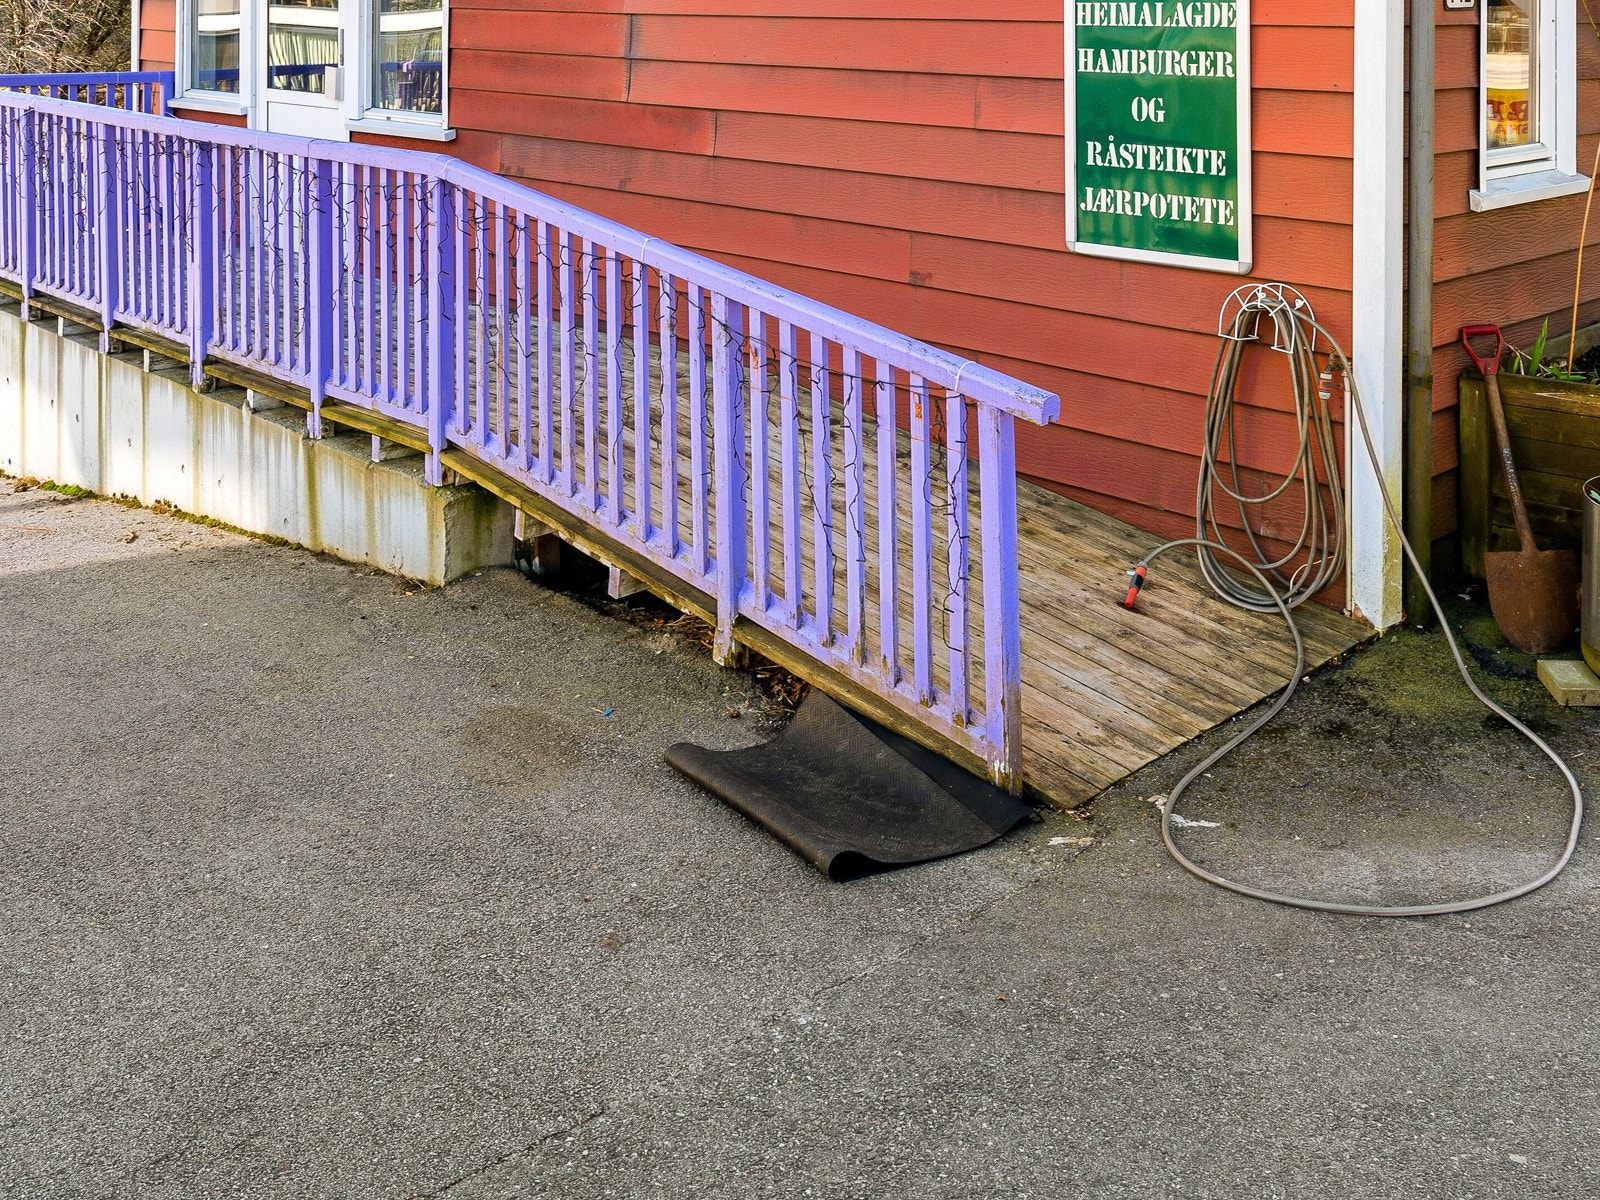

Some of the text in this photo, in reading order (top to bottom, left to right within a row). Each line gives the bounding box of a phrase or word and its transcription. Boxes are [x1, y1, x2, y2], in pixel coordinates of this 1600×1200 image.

[1076, 1, 1236, 28] HEIMALAGDE
[1077, 48, 1235, 78] HAMBURGER
[1131, 96, 1166, 123] OG
[1085, 135, 1226, 177] RÅSTEIKTE
[1080, 186, 1234, 227] JÆRPOTETE
